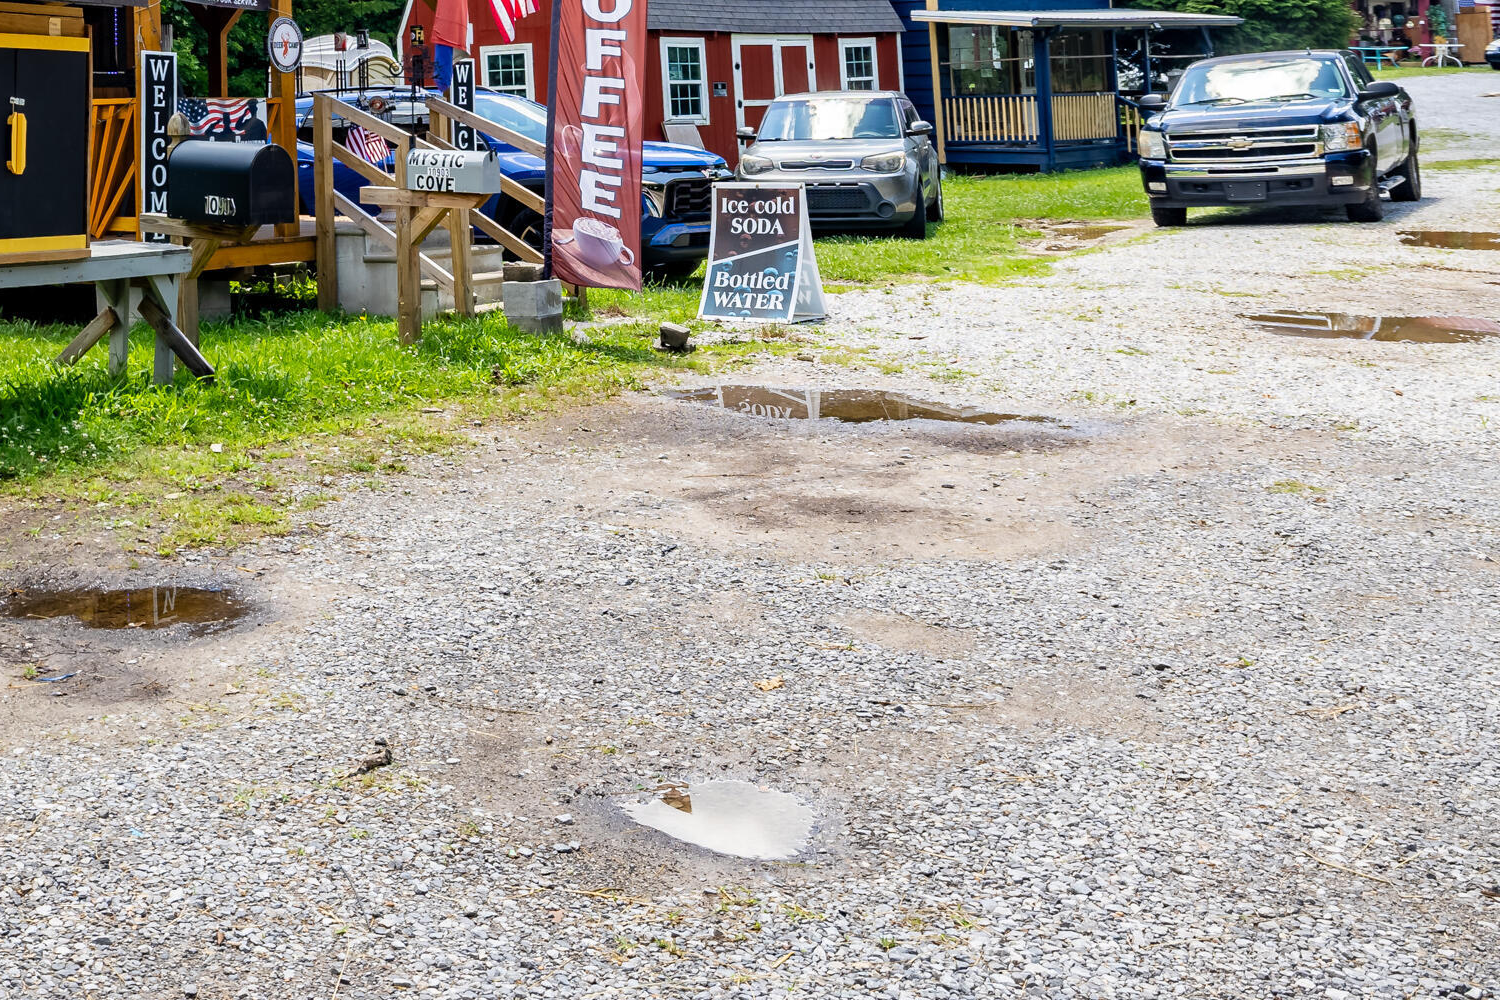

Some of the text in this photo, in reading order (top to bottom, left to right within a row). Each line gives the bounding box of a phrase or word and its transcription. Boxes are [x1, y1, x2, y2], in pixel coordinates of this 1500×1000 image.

[409, 153, 465, 168] MYSTIC
[429, 168, 450, 177] 10903
[416, 175, 455, 192] COVE
[721, 196, 795, 214] Ice cold
[730, 218, 784, 235] SODA
[714, 271, 789, 290] Bottled
[713, 291, 784, 310] WATER
